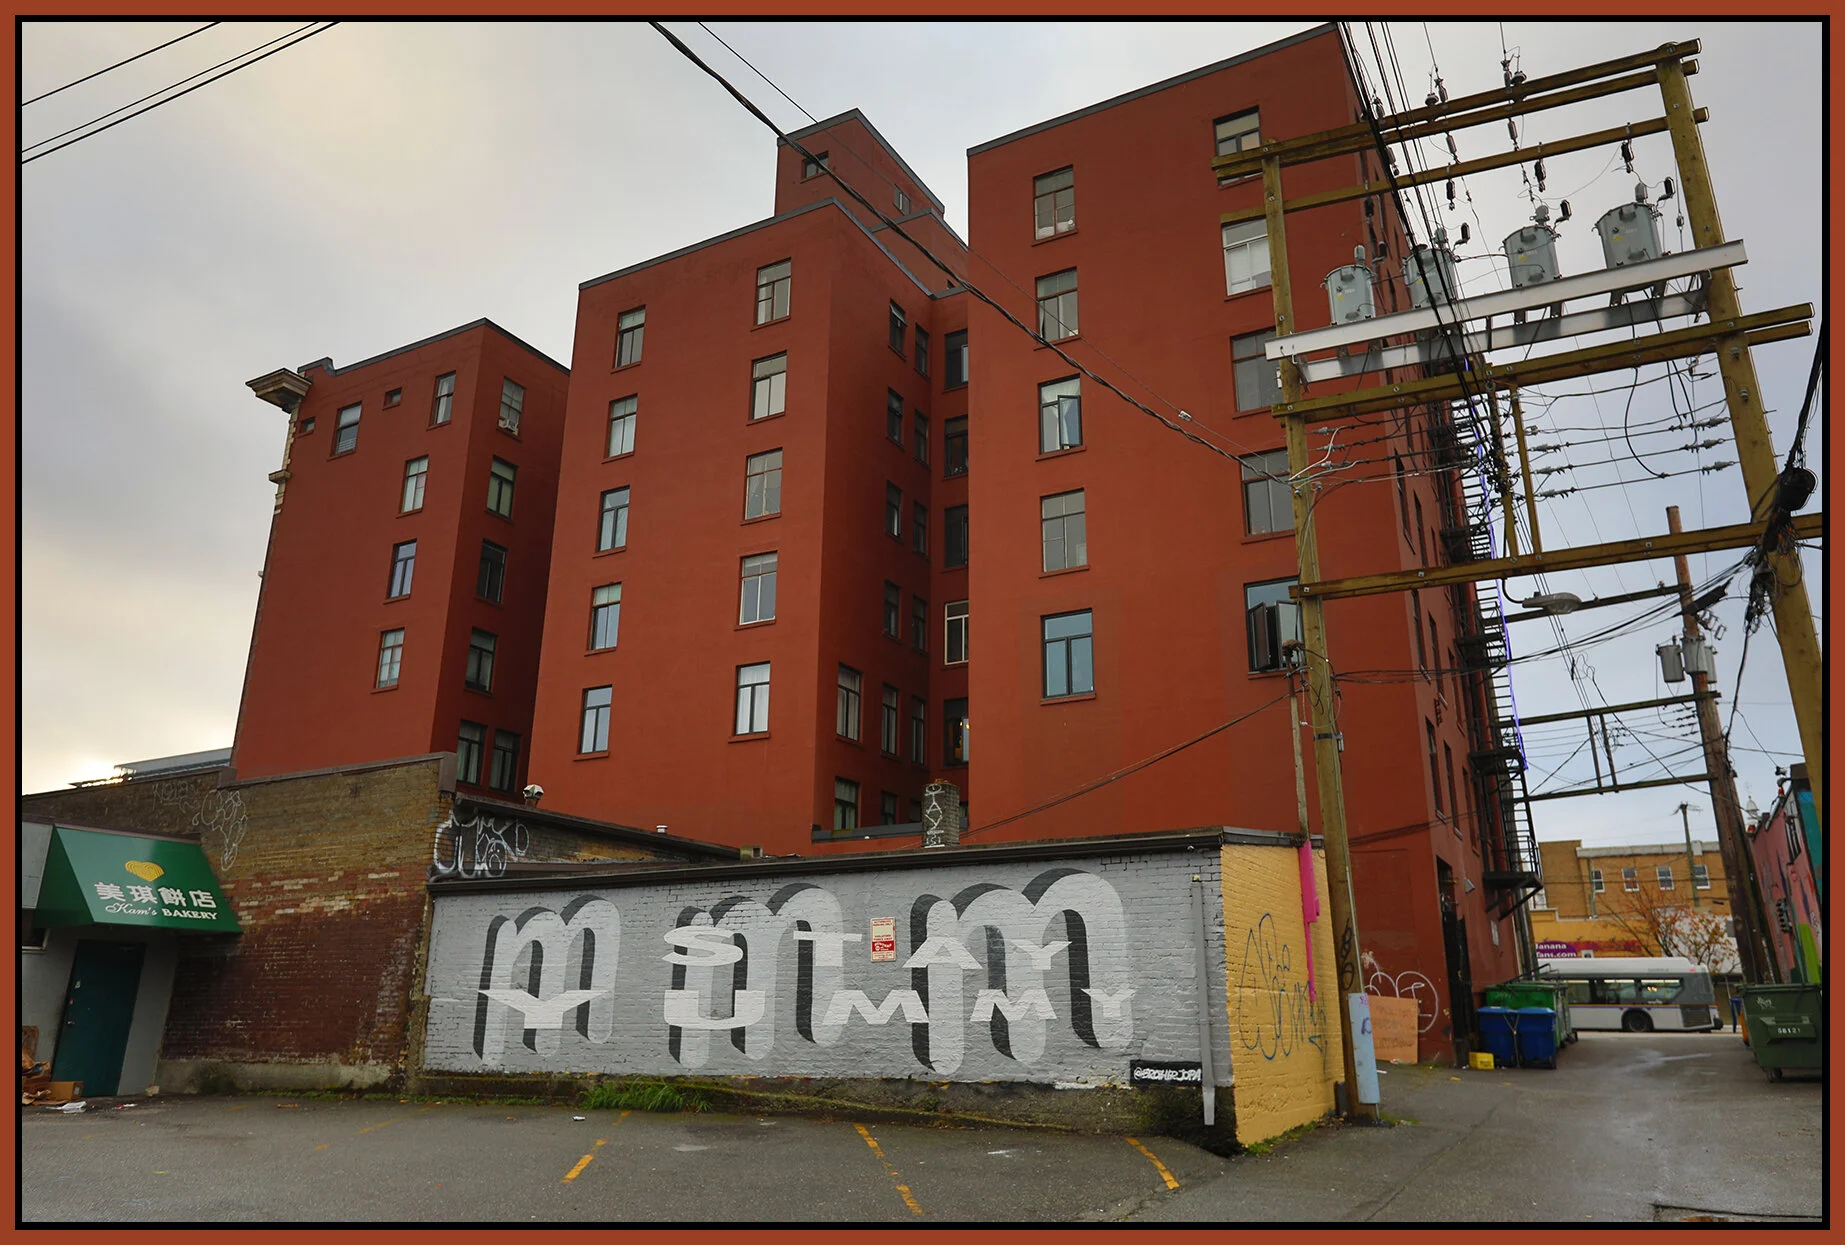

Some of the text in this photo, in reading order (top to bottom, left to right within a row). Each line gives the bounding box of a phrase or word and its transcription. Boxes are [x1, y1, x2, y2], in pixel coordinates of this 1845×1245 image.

[94, 881, 217, 908] 美琪餅店
[105, 902, 218, 920] Kam's BAKERY
[661, 925, 1073, 970] STAY
[477, 986, 1137, 1030] YUMMY
